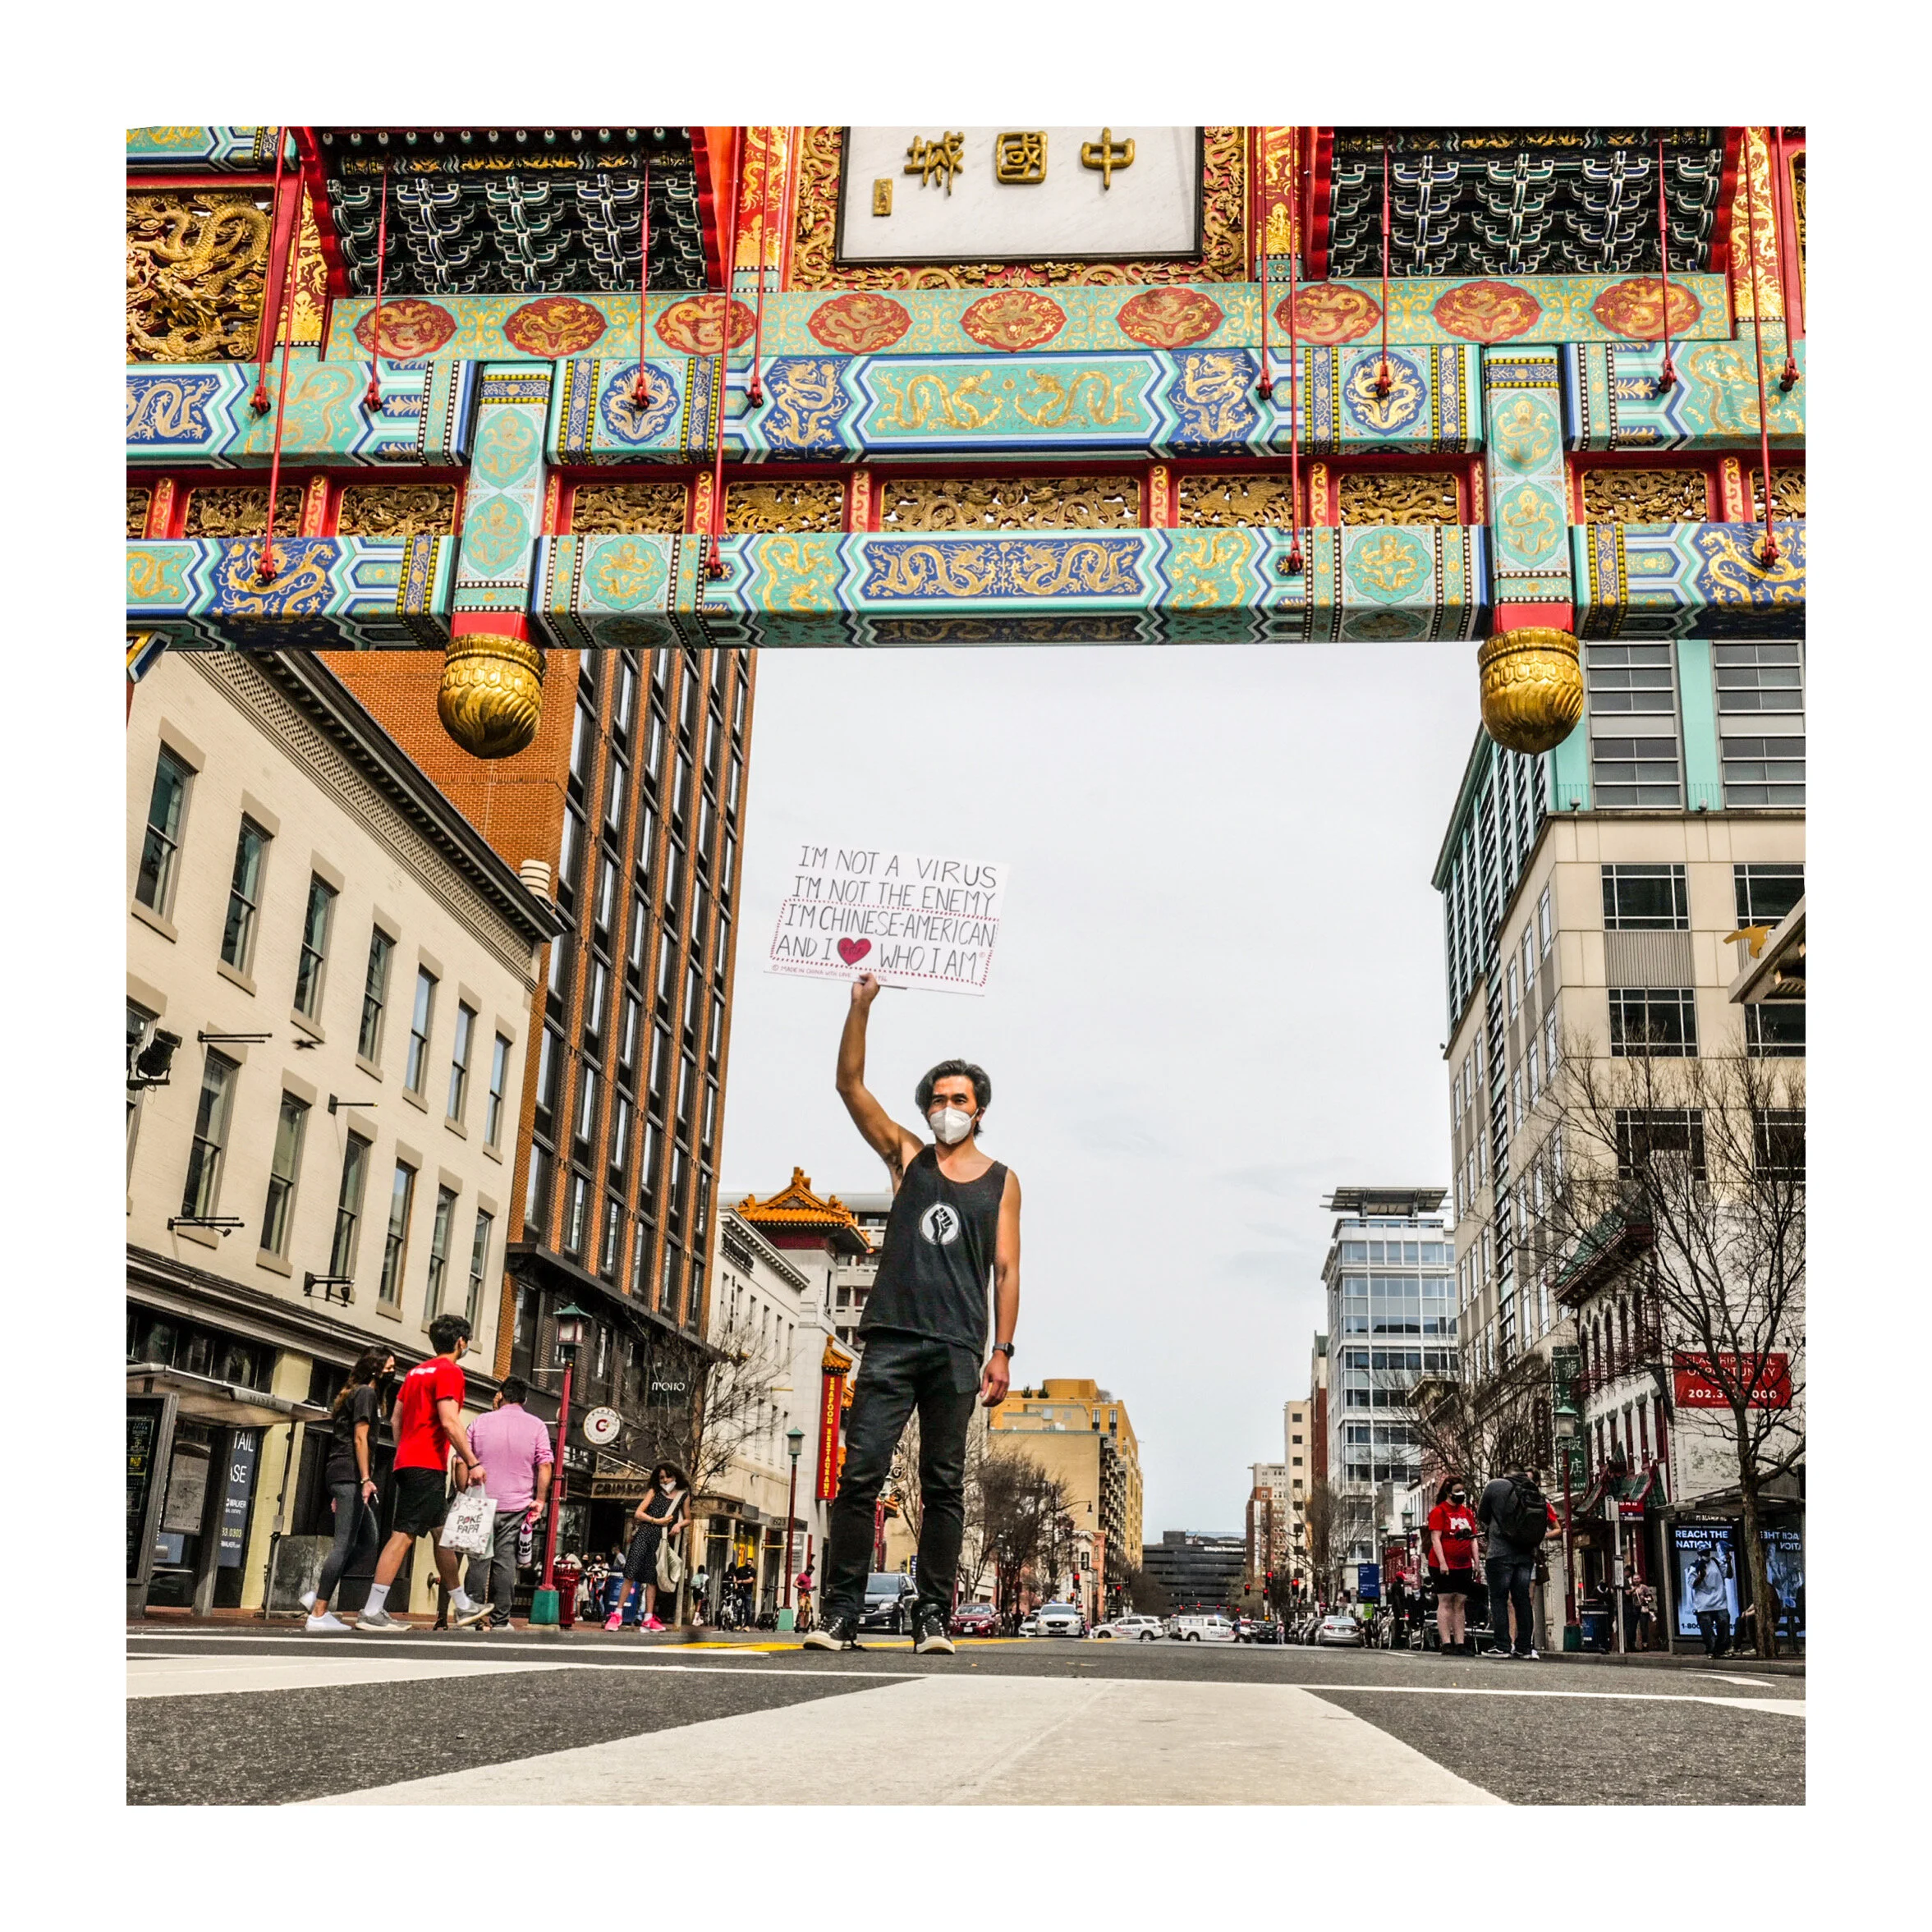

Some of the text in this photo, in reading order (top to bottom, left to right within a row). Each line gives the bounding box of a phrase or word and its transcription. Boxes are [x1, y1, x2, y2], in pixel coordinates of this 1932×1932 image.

[798, 845, 997, 888] I'M NOT A VIRUS
[792, 875, 996, 916] I'M NOT THE ENEMY
[784, 903, 996, 948] I'M CHINESE-AMERICAN
[776, 934, 977, 981] AND I WHO I AM
[826, 1377, 835, 1425] SEAFOOD
[233, 1430, 254, 1452] TAIL
[823, 1428, 833, 1497] RESTAURANT
[594, 1483, 649, 1494] CRIMSO
[457, 1524, 480, 1534] PAPA
[1709, 1530, 1728, 1539] THE
